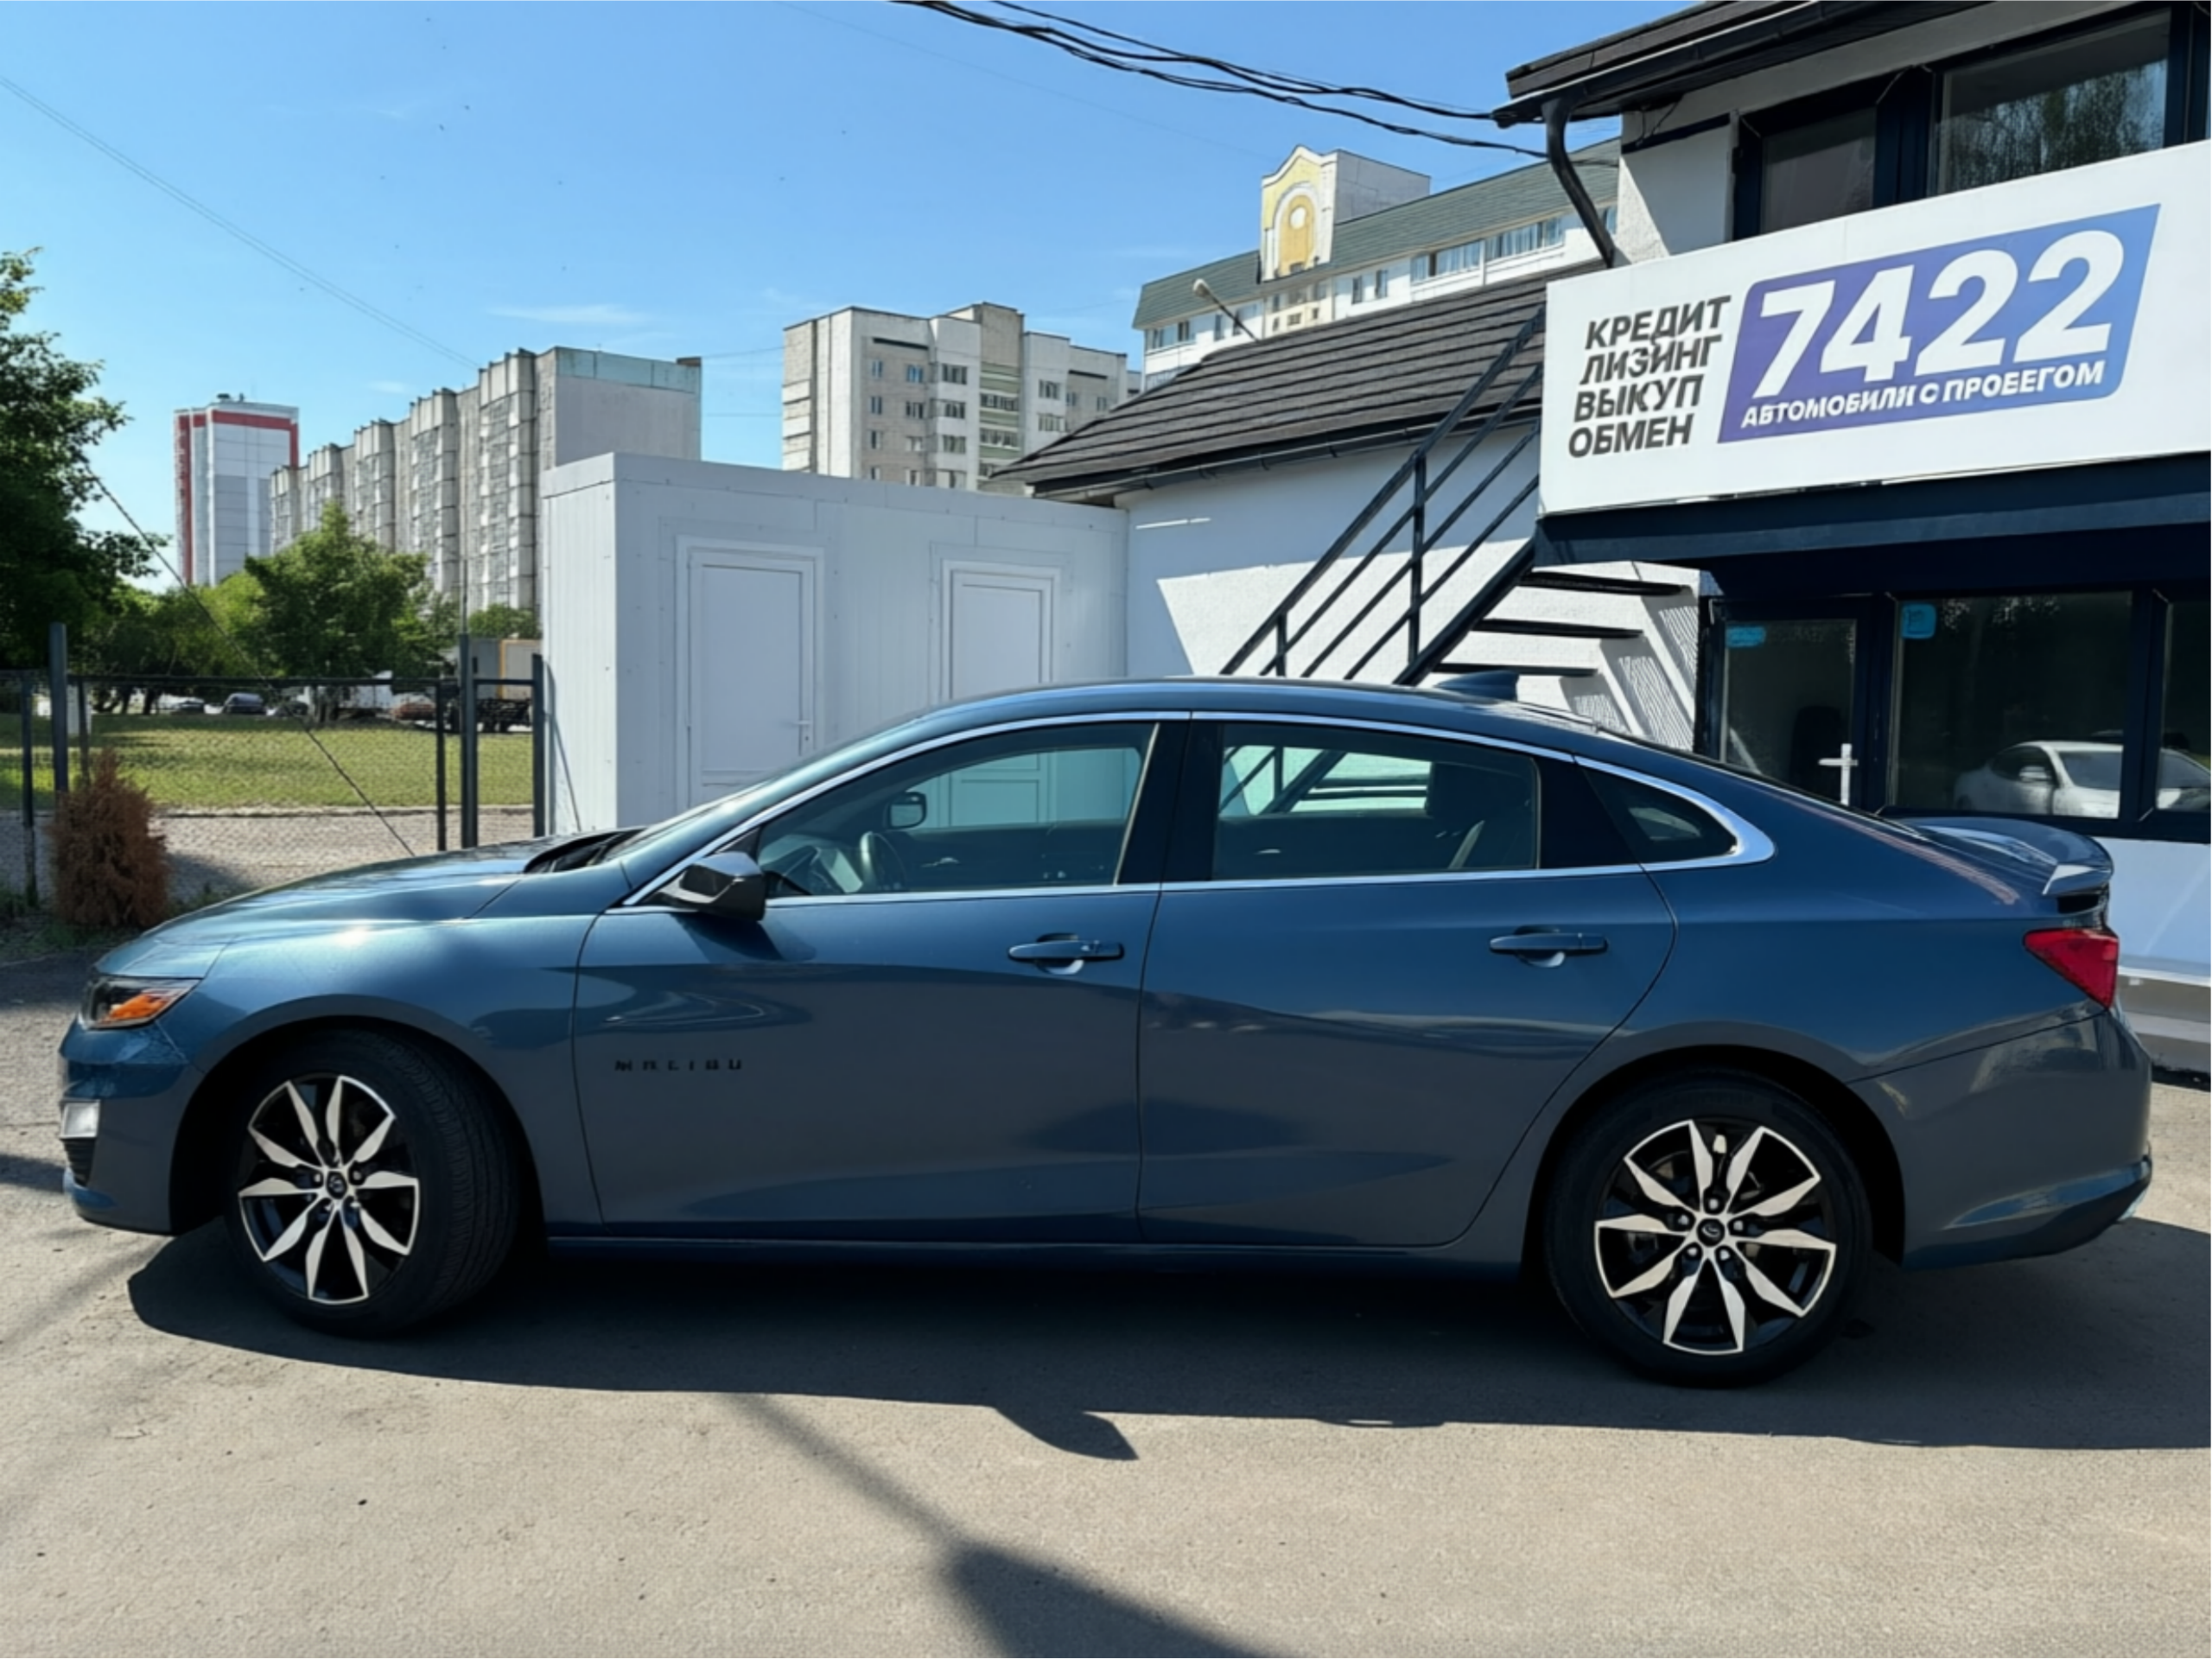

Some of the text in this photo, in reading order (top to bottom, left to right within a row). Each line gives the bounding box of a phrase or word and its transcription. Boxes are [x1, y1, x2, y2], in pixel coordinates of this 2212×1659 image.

[1585, 295, 1732, 350] КРЕДИТ
[1752, 230, 2125, 398] 7422
[1579, 334, 1722, 385] ЛИЗИНГ
[1574, 373, 1705, 423] ВЫКУП
[1740, 385, 1916, 429] АВТОМОБИЛИ
[1919, 382, 1939, 404] С
[1568, 413, 1694, 459] ОБМЕН
